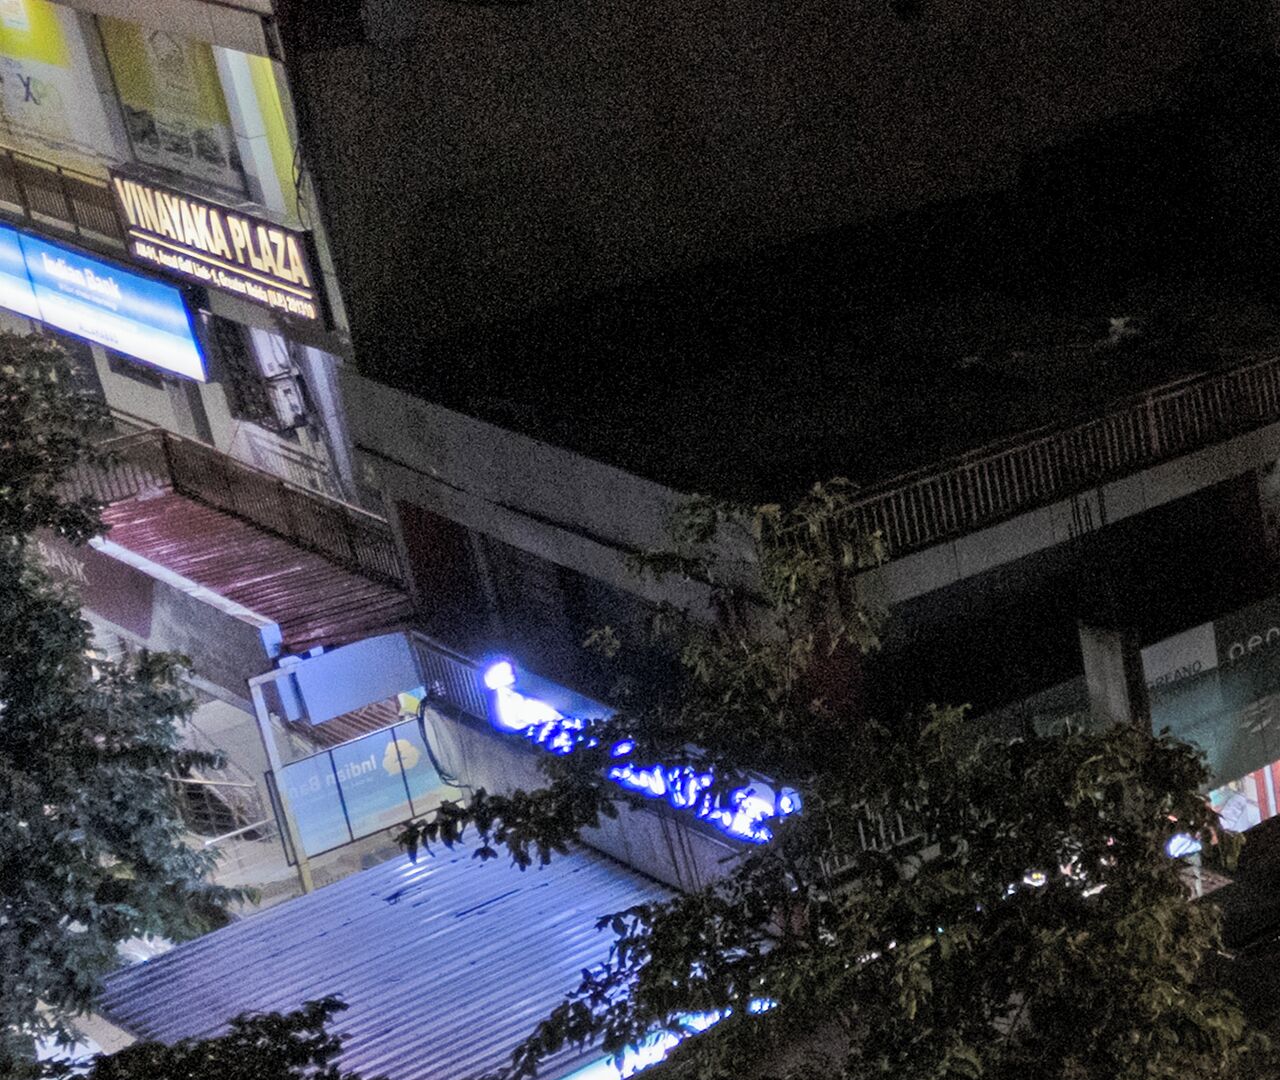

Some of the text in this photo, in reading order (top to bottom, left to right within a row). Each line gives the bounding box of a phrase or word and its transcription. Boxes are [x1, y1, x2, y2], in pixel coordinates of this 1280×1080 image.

[114, 177, 310, 287] VINAYAKA PLAZA
[42, 253, 86, 287] Indian
[84, 268, 122, 300] Bank
